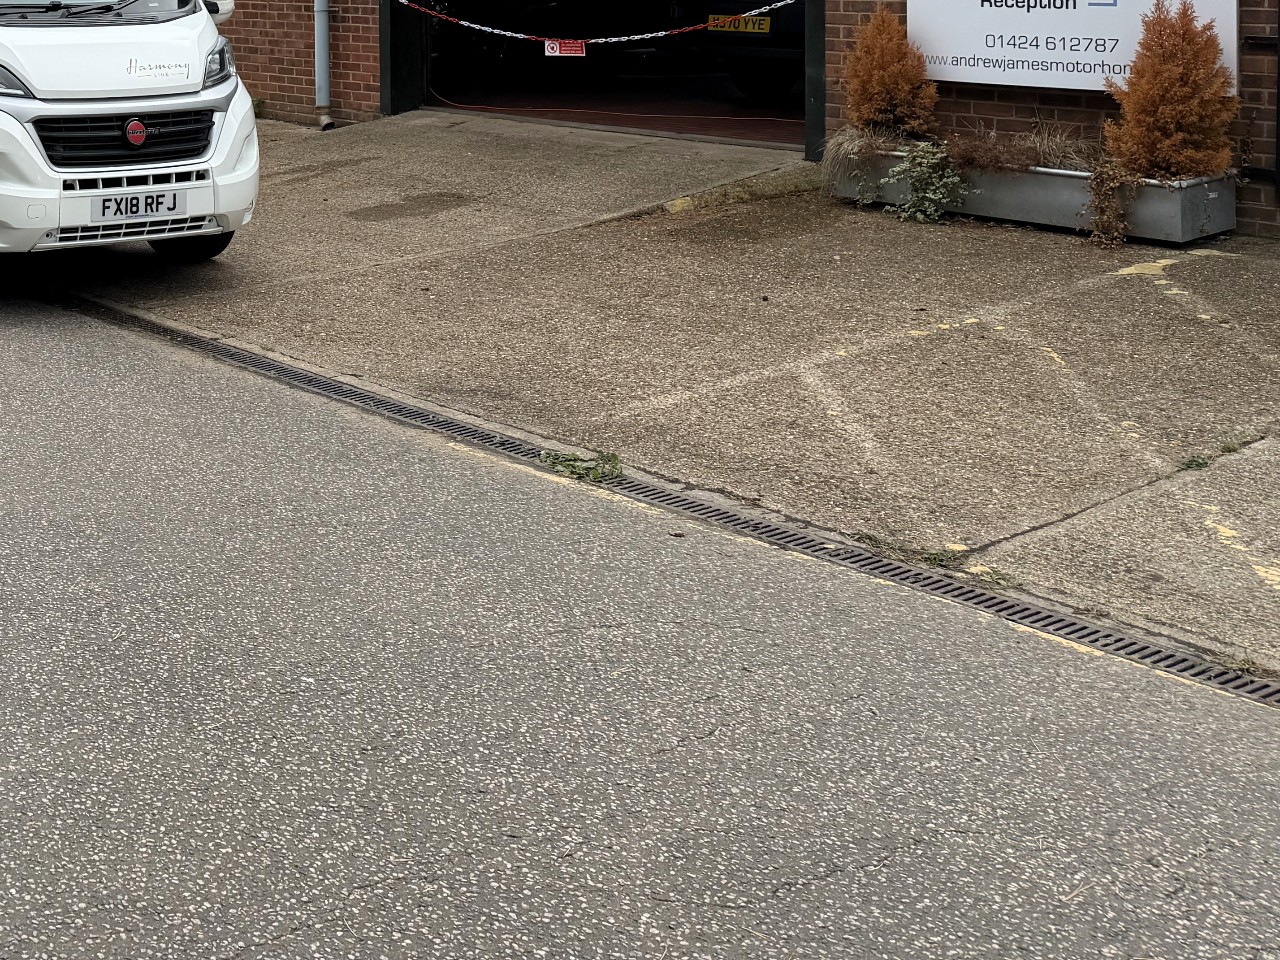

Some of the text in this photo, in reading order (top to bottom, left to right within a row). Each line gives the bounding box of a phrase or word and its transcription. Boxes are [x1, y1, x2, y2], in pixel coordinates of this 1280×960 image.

[743, 18, 766, 31] YYE
[985, 34, 1120, 53] 01424 612787
[126, 58, 190, 80] Harmony
[101, 192, 177, 217] FX18 RFJ
